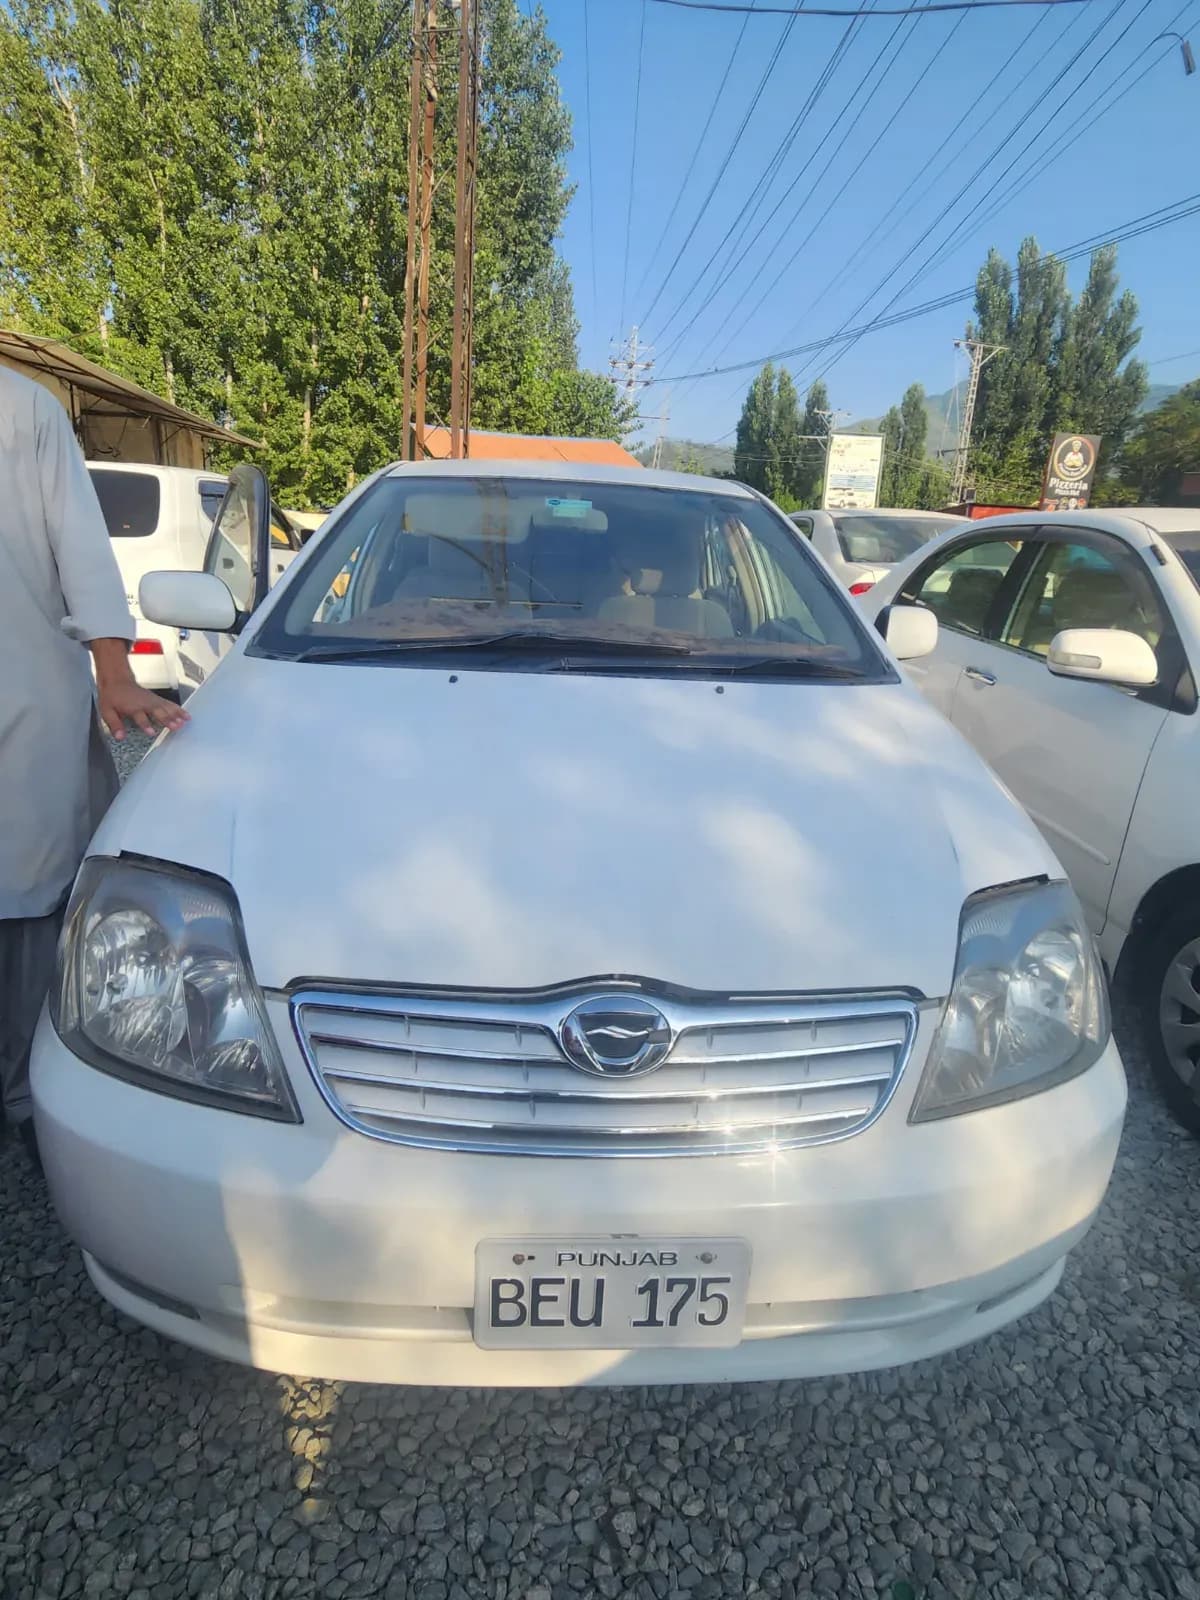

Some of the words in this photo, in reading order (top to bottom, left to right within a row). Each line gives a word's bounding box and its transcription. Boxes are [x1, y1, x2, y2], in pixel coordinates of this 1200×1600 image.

[1049, 477, 1088, 490] Pizzeria
[557, 1252, 679, 1266] PUNJAB
[491, 1277, 605, 1328] BEU
[632, 1276, 731, 1328] 175
